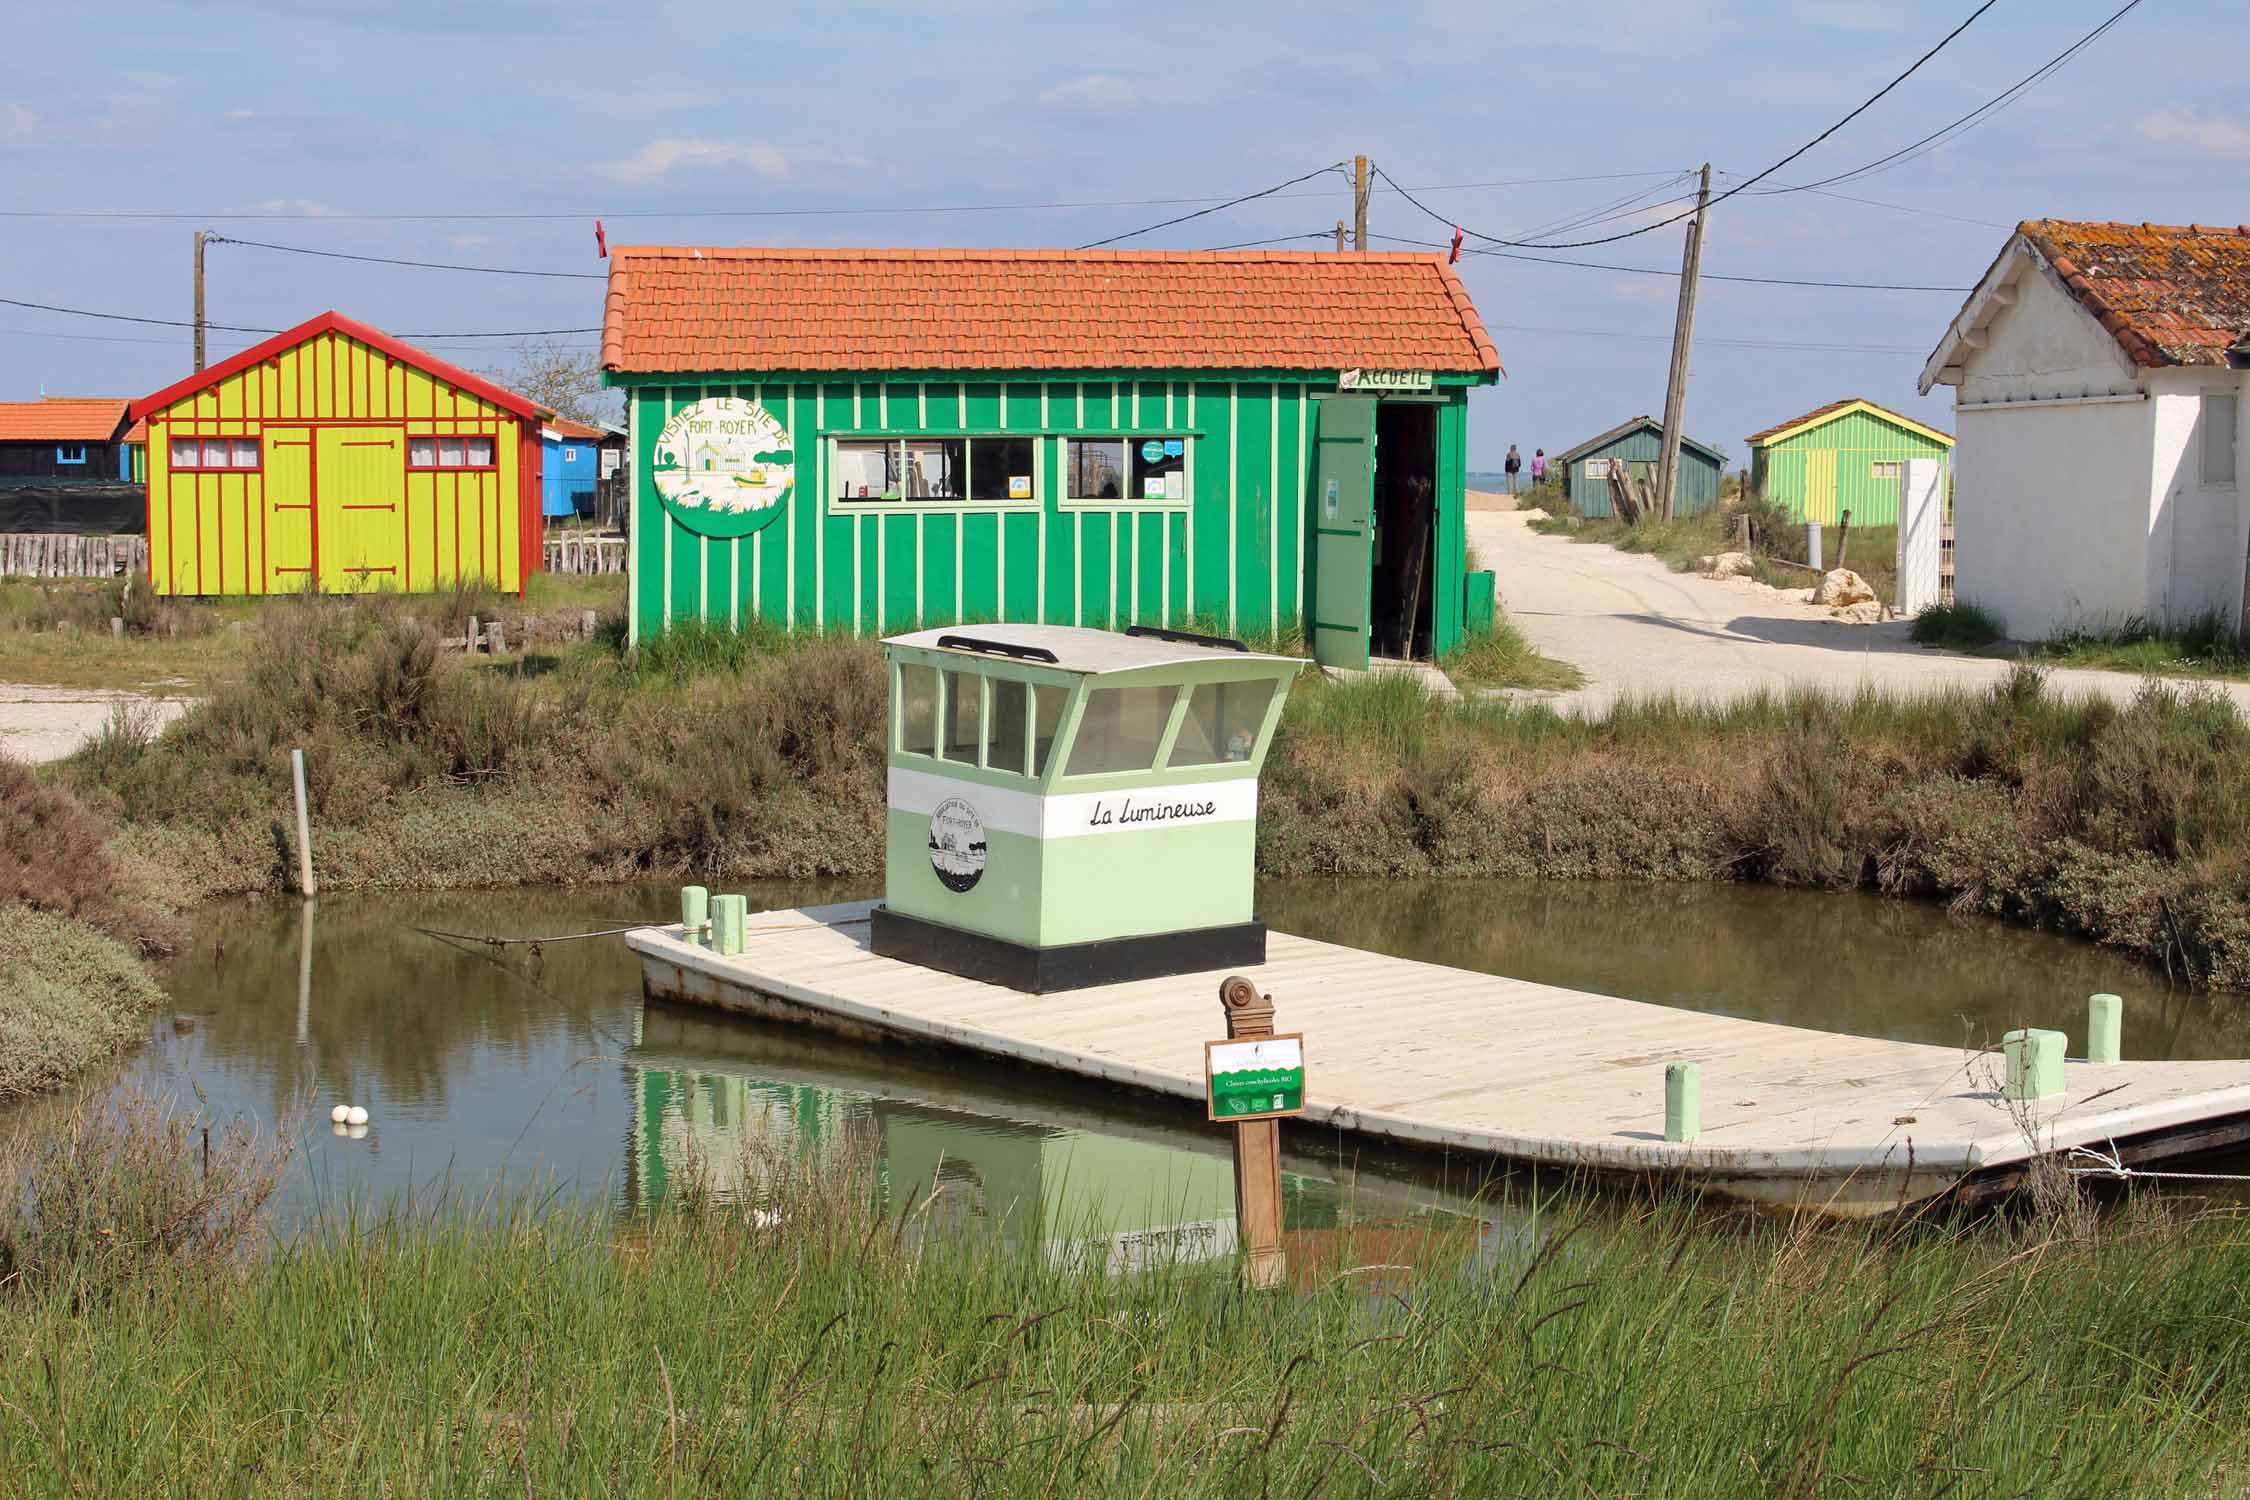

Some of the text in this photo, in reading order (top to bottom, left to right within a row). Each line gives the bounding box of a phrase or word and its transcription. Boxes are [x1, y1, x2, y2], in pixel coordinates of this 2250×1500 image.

[1358, 371, 1427, 386] ACCUEIL
[658, 397, 791, 448] VISITEZ LE SITE DE
[1090, 798, 1216, 826] La Lumineuse
